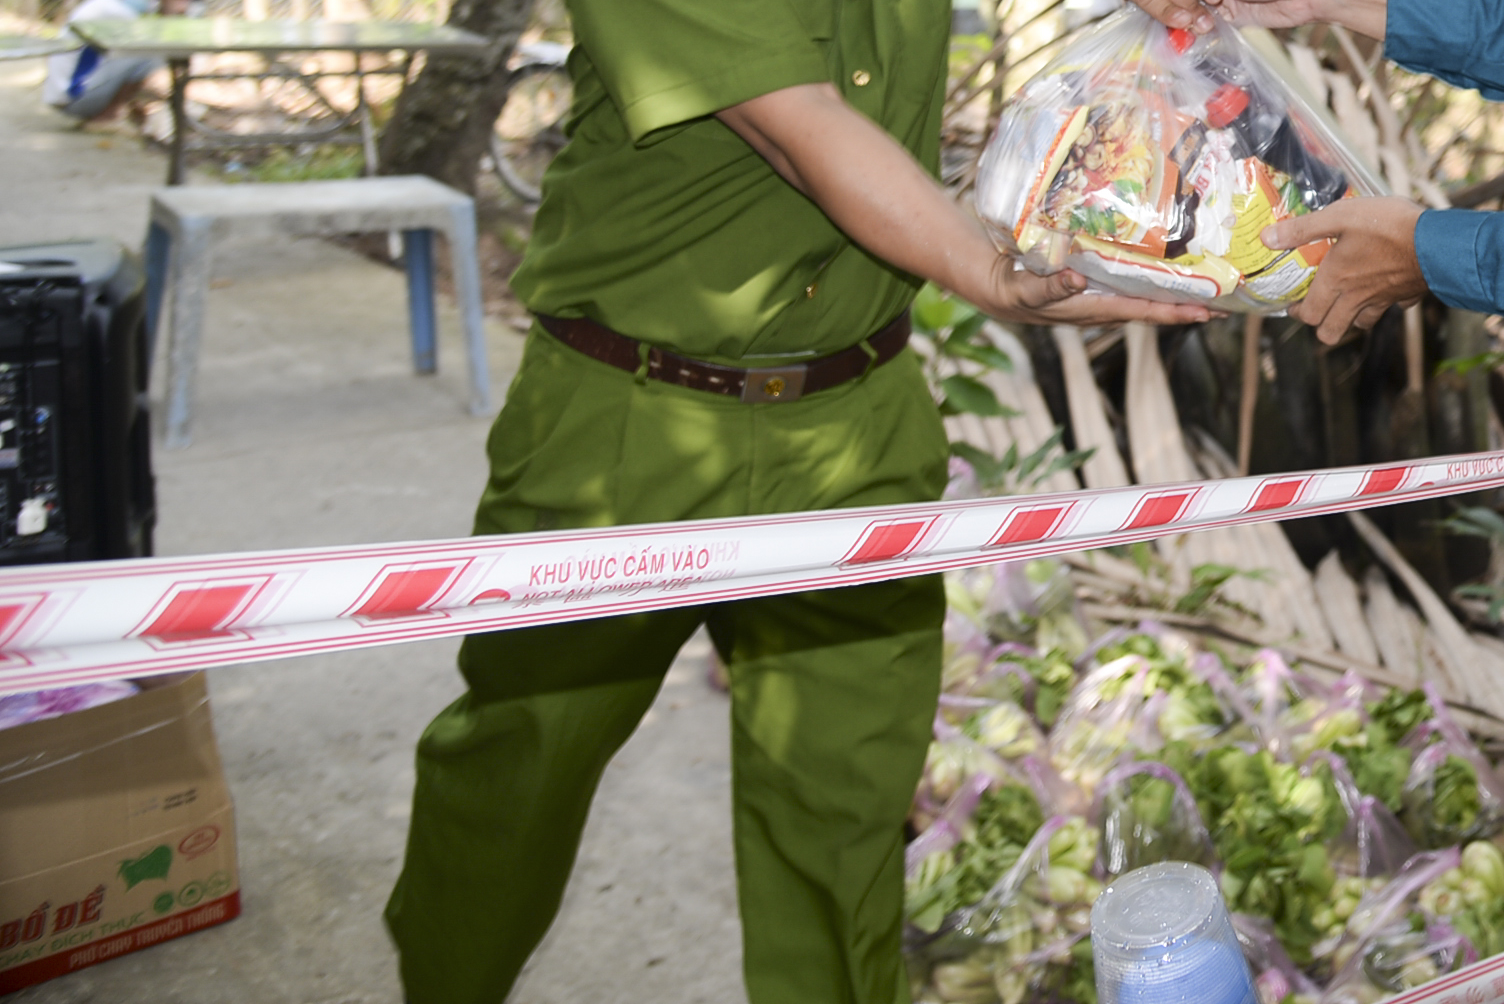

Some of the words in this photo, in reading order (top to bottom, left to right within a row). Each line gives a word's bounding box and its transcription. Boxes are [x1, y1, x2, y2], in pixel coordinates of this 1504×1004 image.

[528, 561, 572, 587] KHU
[578, 554, 618, 585] VỰC
[622, 545, 666, 577] CẤM
[672, 544, 710, 572] VÀO
